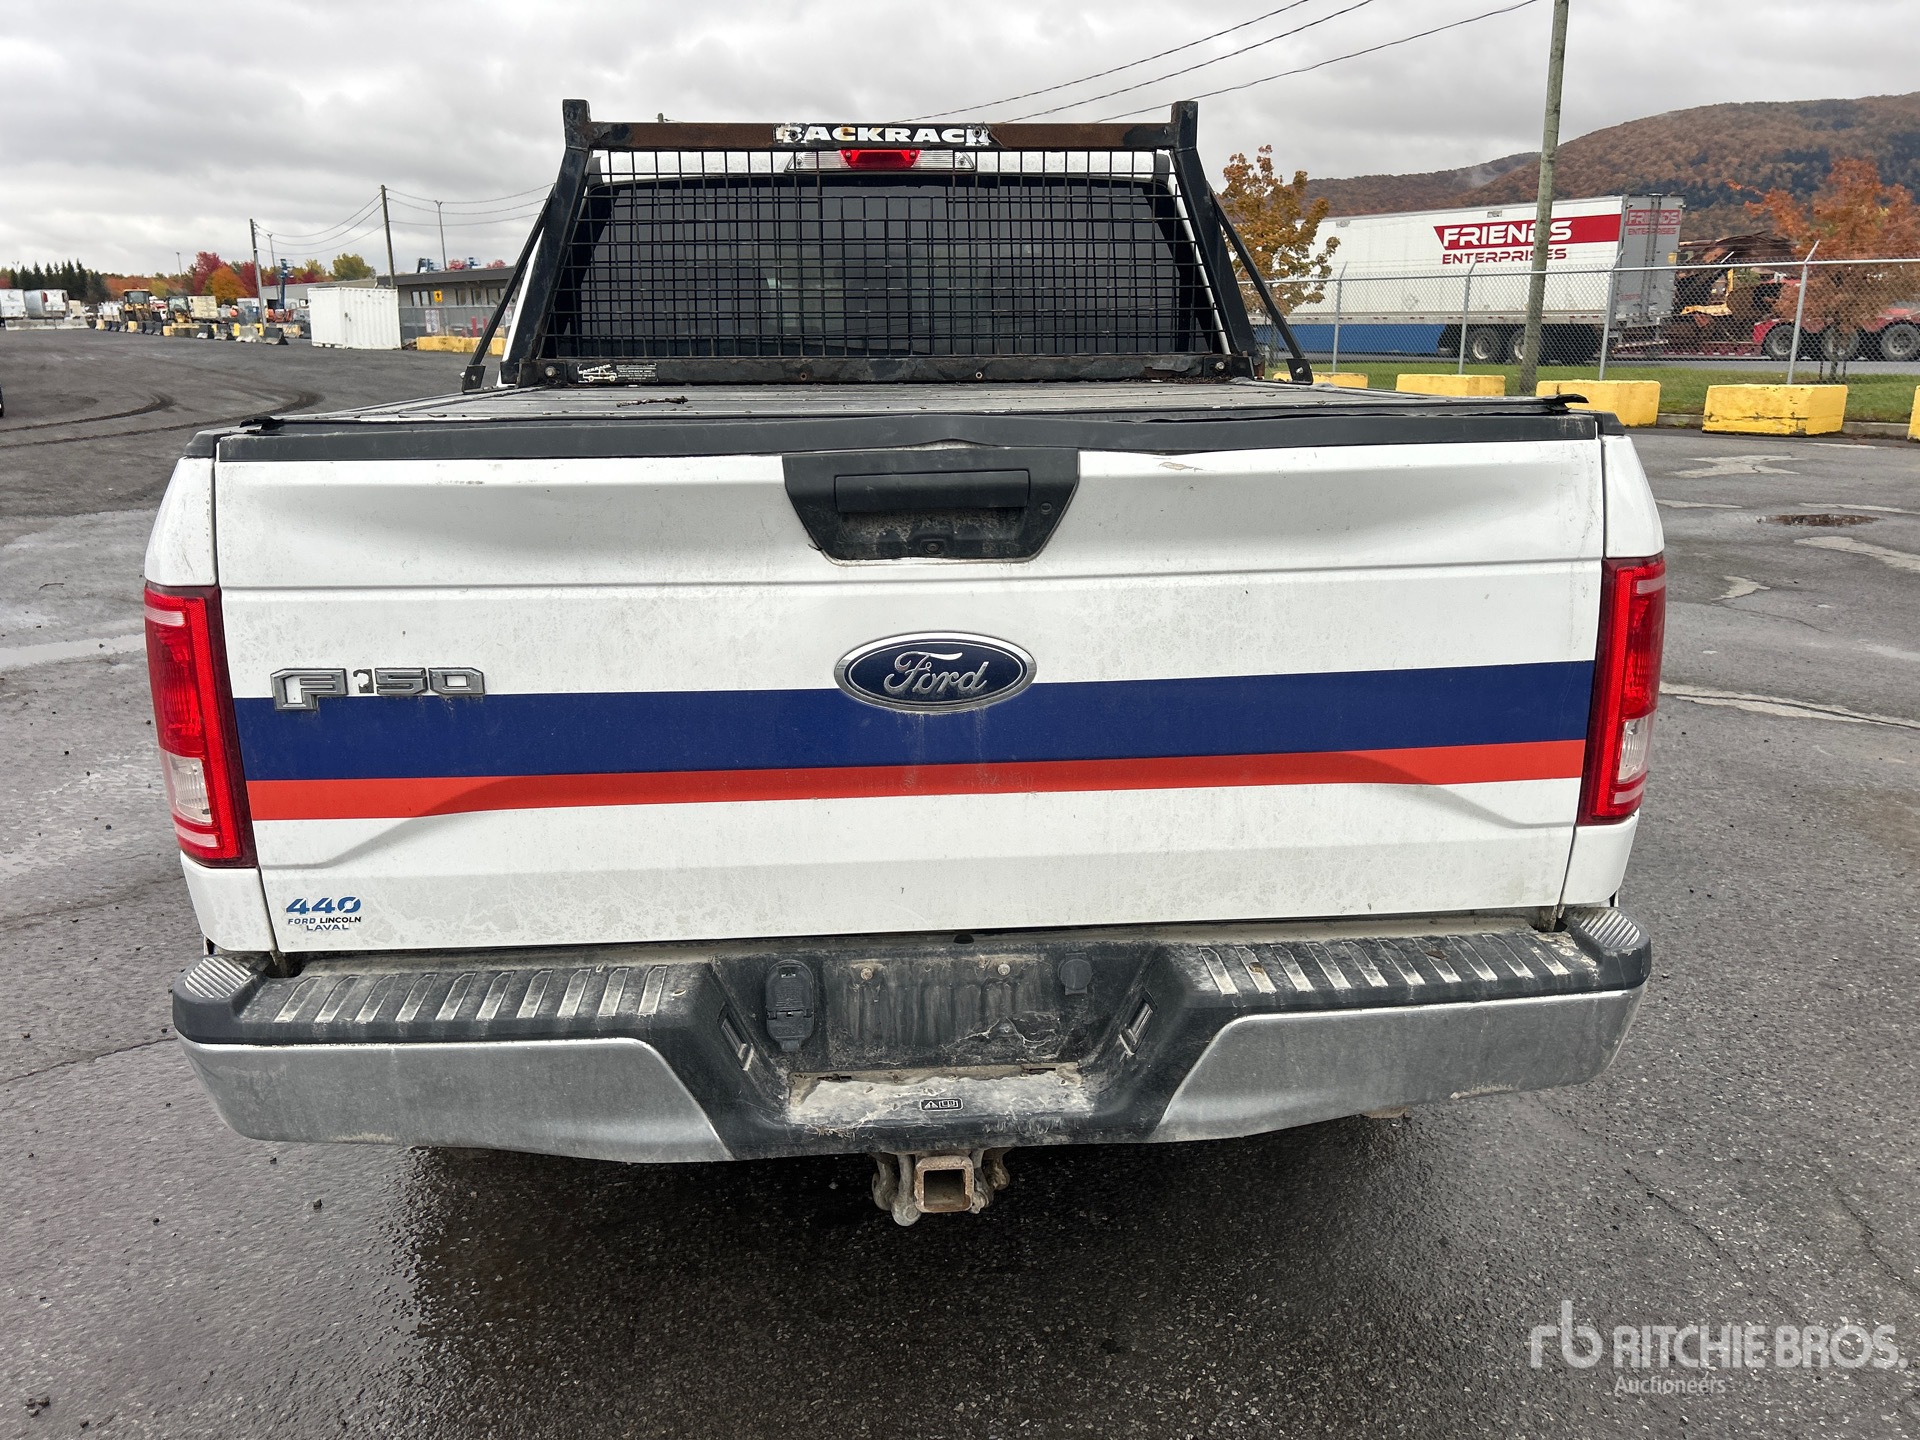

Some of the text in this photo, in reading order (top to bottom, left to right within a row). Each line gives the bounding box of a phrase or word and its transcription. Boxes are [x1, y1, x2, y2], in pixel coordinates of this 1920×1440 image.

[1442, 248, 1567, 265] ENTERPRIES
[883, 650, 990, 695] Ford
[286, 896, 362, 915] 440
[288, 916, 362, 925] FORD LINCOLN
